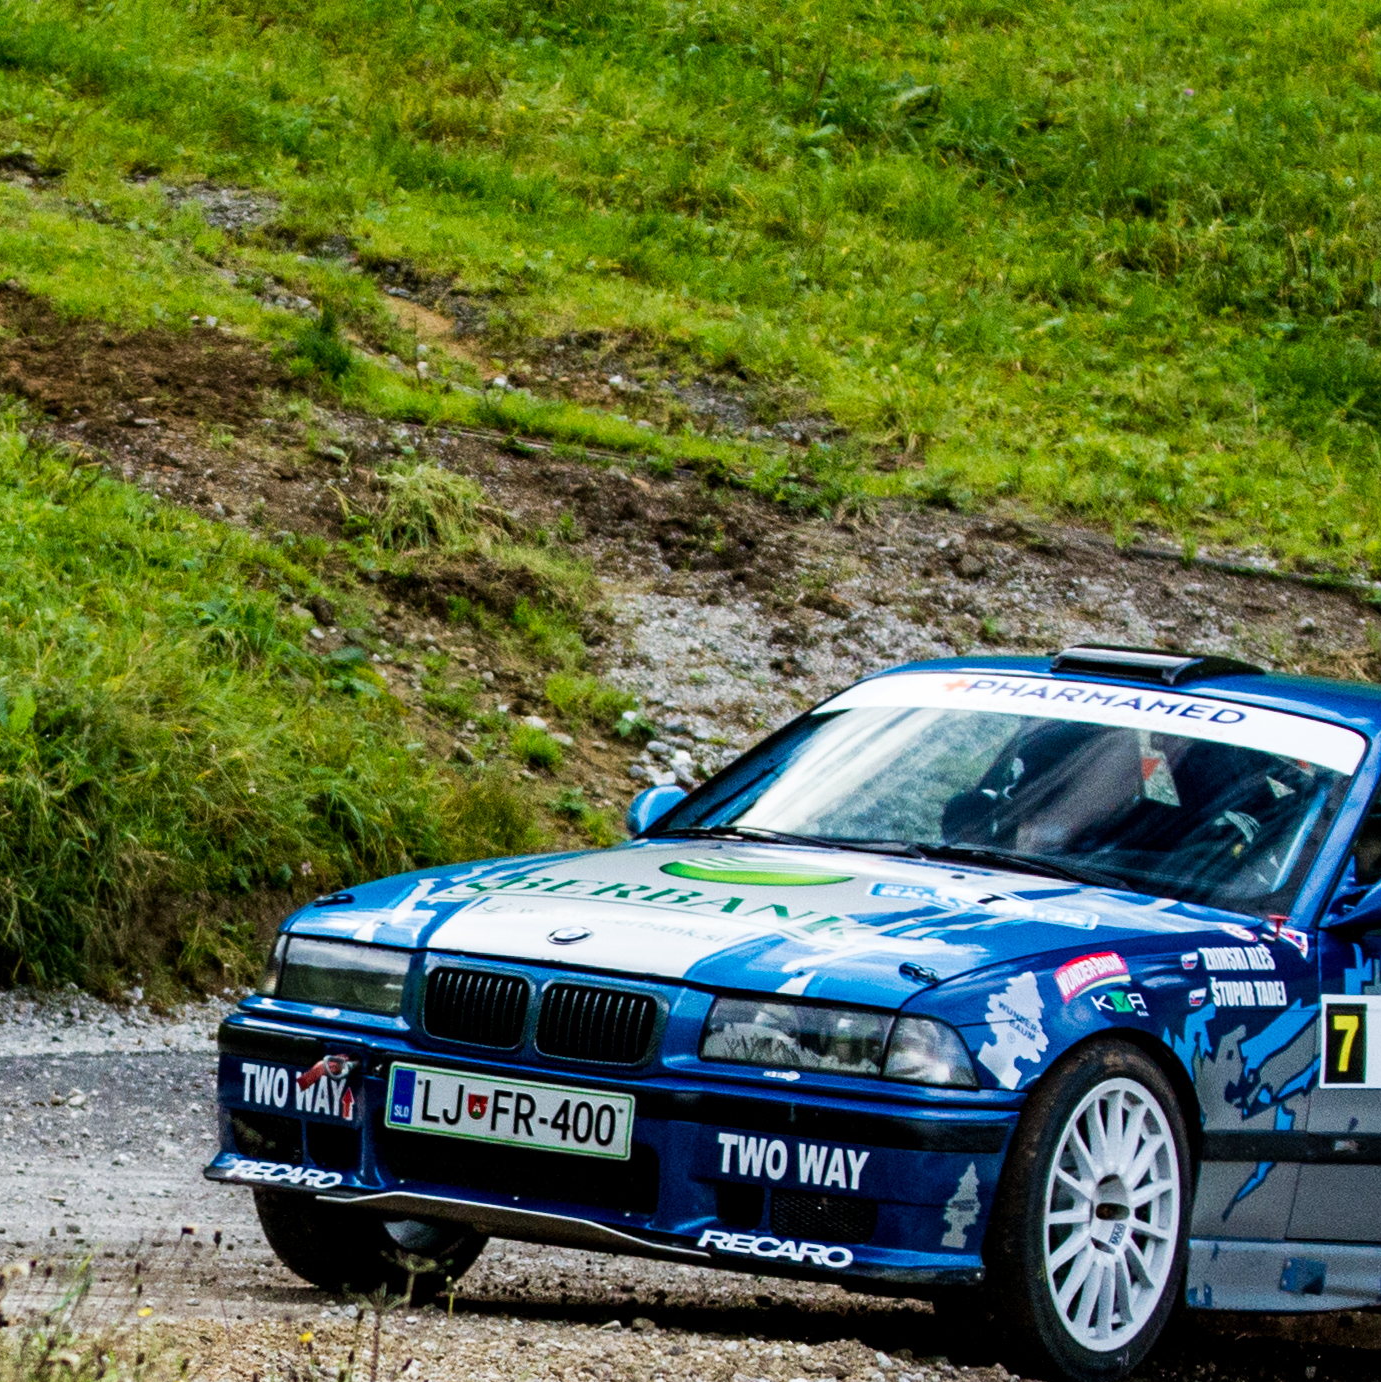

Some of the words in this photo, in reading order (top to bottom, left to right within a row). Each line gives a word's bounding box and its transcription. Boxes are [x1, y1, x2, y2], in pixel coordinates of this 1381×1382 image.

[968, 679, 1247, 725] PHARMAMED
[445, 876, 868, 943] SBERBANK
[1210, 977, 1256, 1006] ŠTUPAR
[1254, 981, 1287, 1006] TADEJ
[1333, 1015, 1359, 1072] 7
[241, 1062, 289, 1108] TWO
[295, 1070, 347, 1117] WAY
[394, 1104, 409, 1119] SLO
[422, 1079, 465, 1126] LJ
[490, 1089, 616, 1146] FR-400
[225, 1159, 343, 1189] RECARO
[718, 1132, 788, 1181] TWO
[799, 1143, 870, 1190] WAY
[697, 1229, 854, 1268] RECARO
